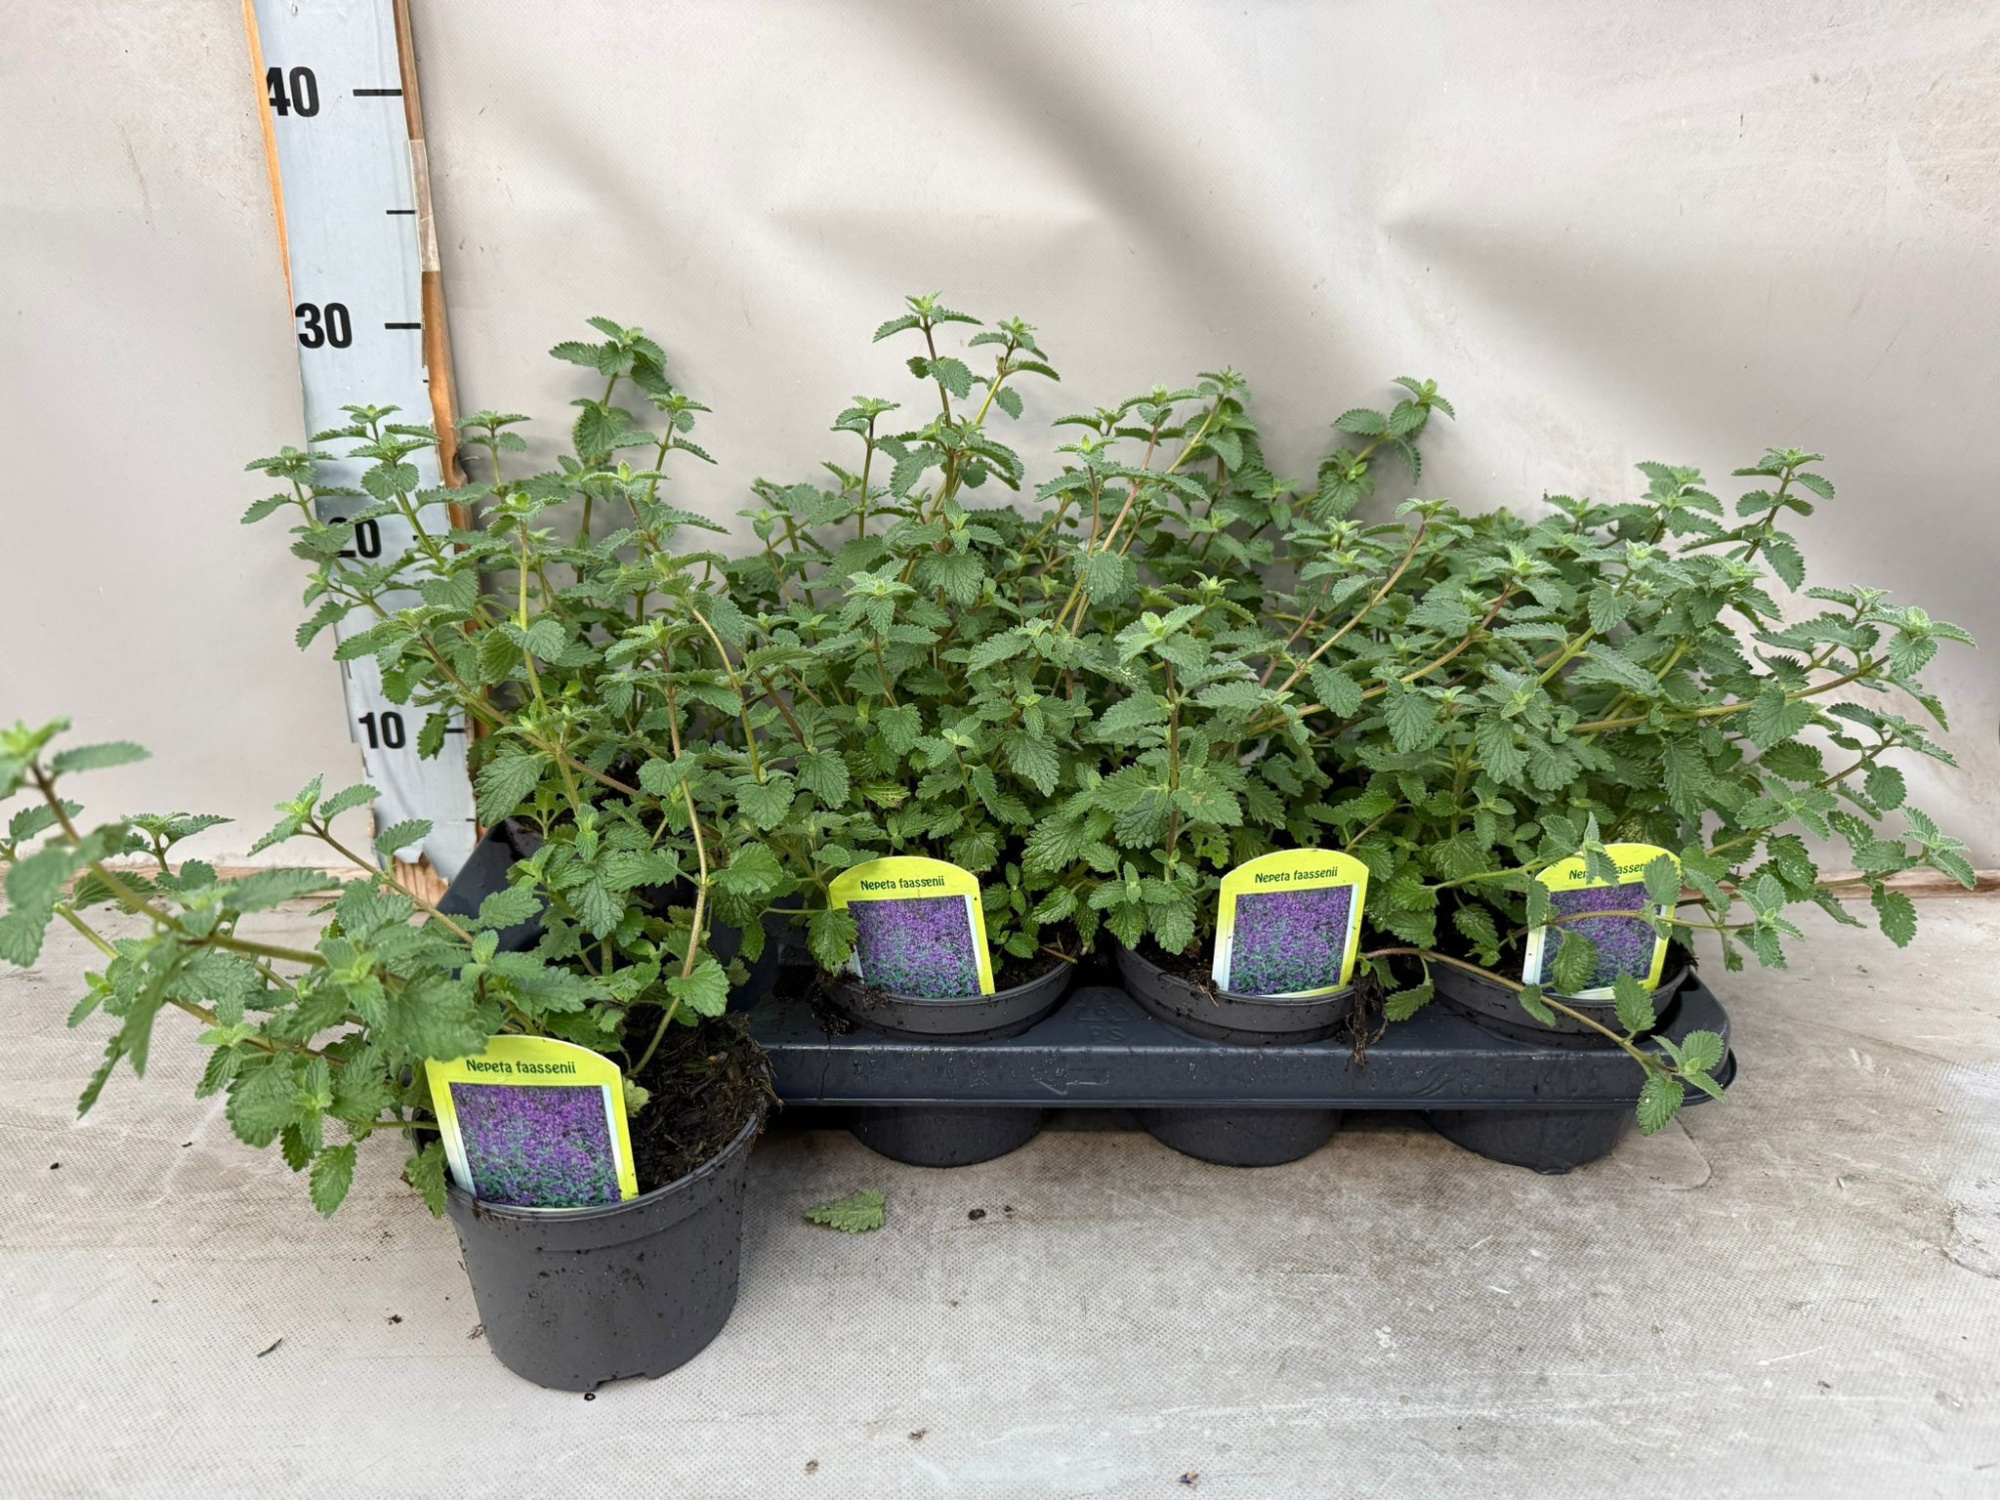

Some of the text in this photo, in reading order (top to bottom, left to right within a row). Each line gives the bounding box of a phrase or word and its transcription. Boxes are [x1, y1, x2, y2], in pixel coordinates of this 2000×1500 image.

[266, 66, 320, 117] 40
[294, 302, 352, 349] 30
[358, 711, 406, 749] 10
[860, 876, 946, 891] Nepeta faassenii
[1255, 867, 1339, 884] Nepeta faassenii
[466, 1059, 577, 1075] Nepeta faassenii
